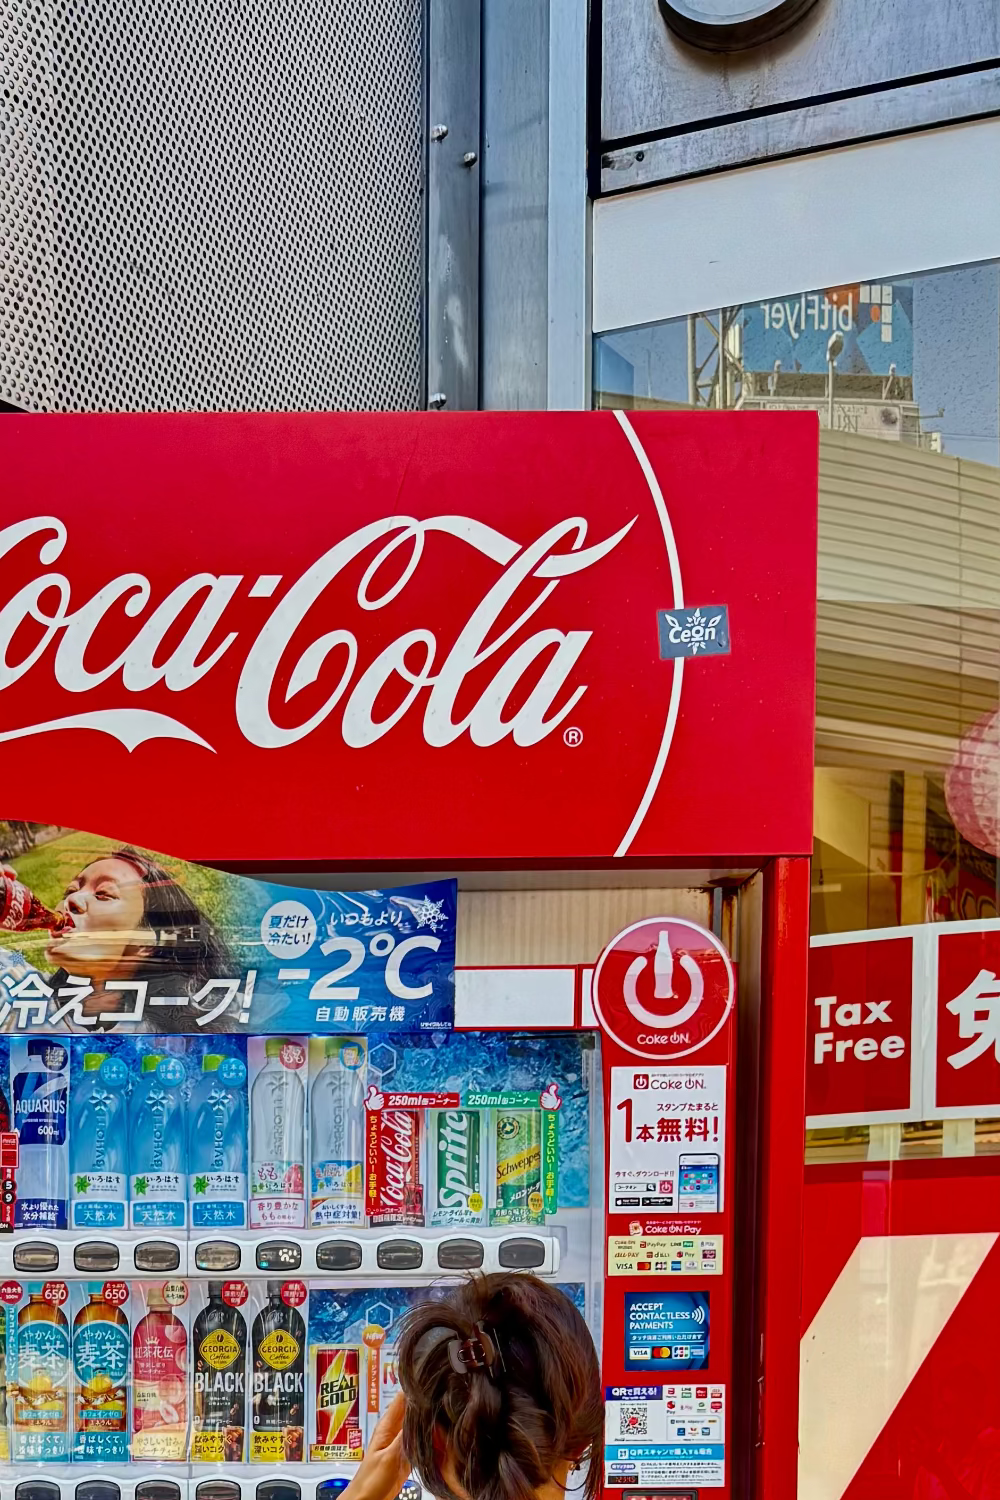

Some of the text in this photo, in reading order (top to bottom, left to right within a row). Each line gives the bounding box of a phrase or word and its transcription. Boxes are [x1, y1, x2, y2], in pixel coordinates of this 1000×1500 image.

[268, 914, 309, 929] 夏だけ
[330, 911, 403, 926] いつもより
[315, 1006, 406, 1022] 自動販売機
[813, 996, 905, 1064] Tax Free
[637, 1034, 668, 1045] Coke
[283, 1044, 305, 1063] もも
[650, 1079, 682, 1090] Coke
[15, 1100, 65, 1115] AQUARIUS
[656, 1103, 719, 1112] スタンプたまると
[616, 1098, 719, 1143] 1本無料!
[37, 1126, 59, 1136] 600ml
[439, 1111, 473, 1208] Sprite
[496, 1150, 540, 1180] Schweppes
[258, 1167, 278, 1180] もも
[257, 1202, 299, 1211] 香り豊かな
[23, 1211, 56, 1221] 水分補給
[83, 1210, 117, 1221] 天然水
[142, 1210, 176, 1221] 天然水
[202, 1210, 236, 1221] 天然水
[645, 1225, 667, 1234] Coke
[684, 1225, 701, 1236] Pay
[44, 1289, 67, 1300] 650
[104, 1289, 127, 1300] 650
[630, 1303, 664, 1311] ACCEPT
[629, 1312, 690, 1320] CONTACTLESS
[630, 1321, 673, 1330] PAYMENTS
[134, 1345, 173, 1360] 紅茶花伝
[202, 1345, 237, 1353] GEORGIA
[261, 1345, 297, 1353] GEORGIA
[18, 1341, 66, 1370] 麦茶
[75, 1341, 127, 1370] 麦茶
[195, 1371, 245, 1393] BLACK
[254, 1371, 304, 1393] BLACK
[320, 1375, 356, 1393] REAL
[320, 1389, 357, 1409] GOLD
[254, 1434, 291, 1444] 飲みやすく
[254, 1444, 285, 1453] 深いコク
